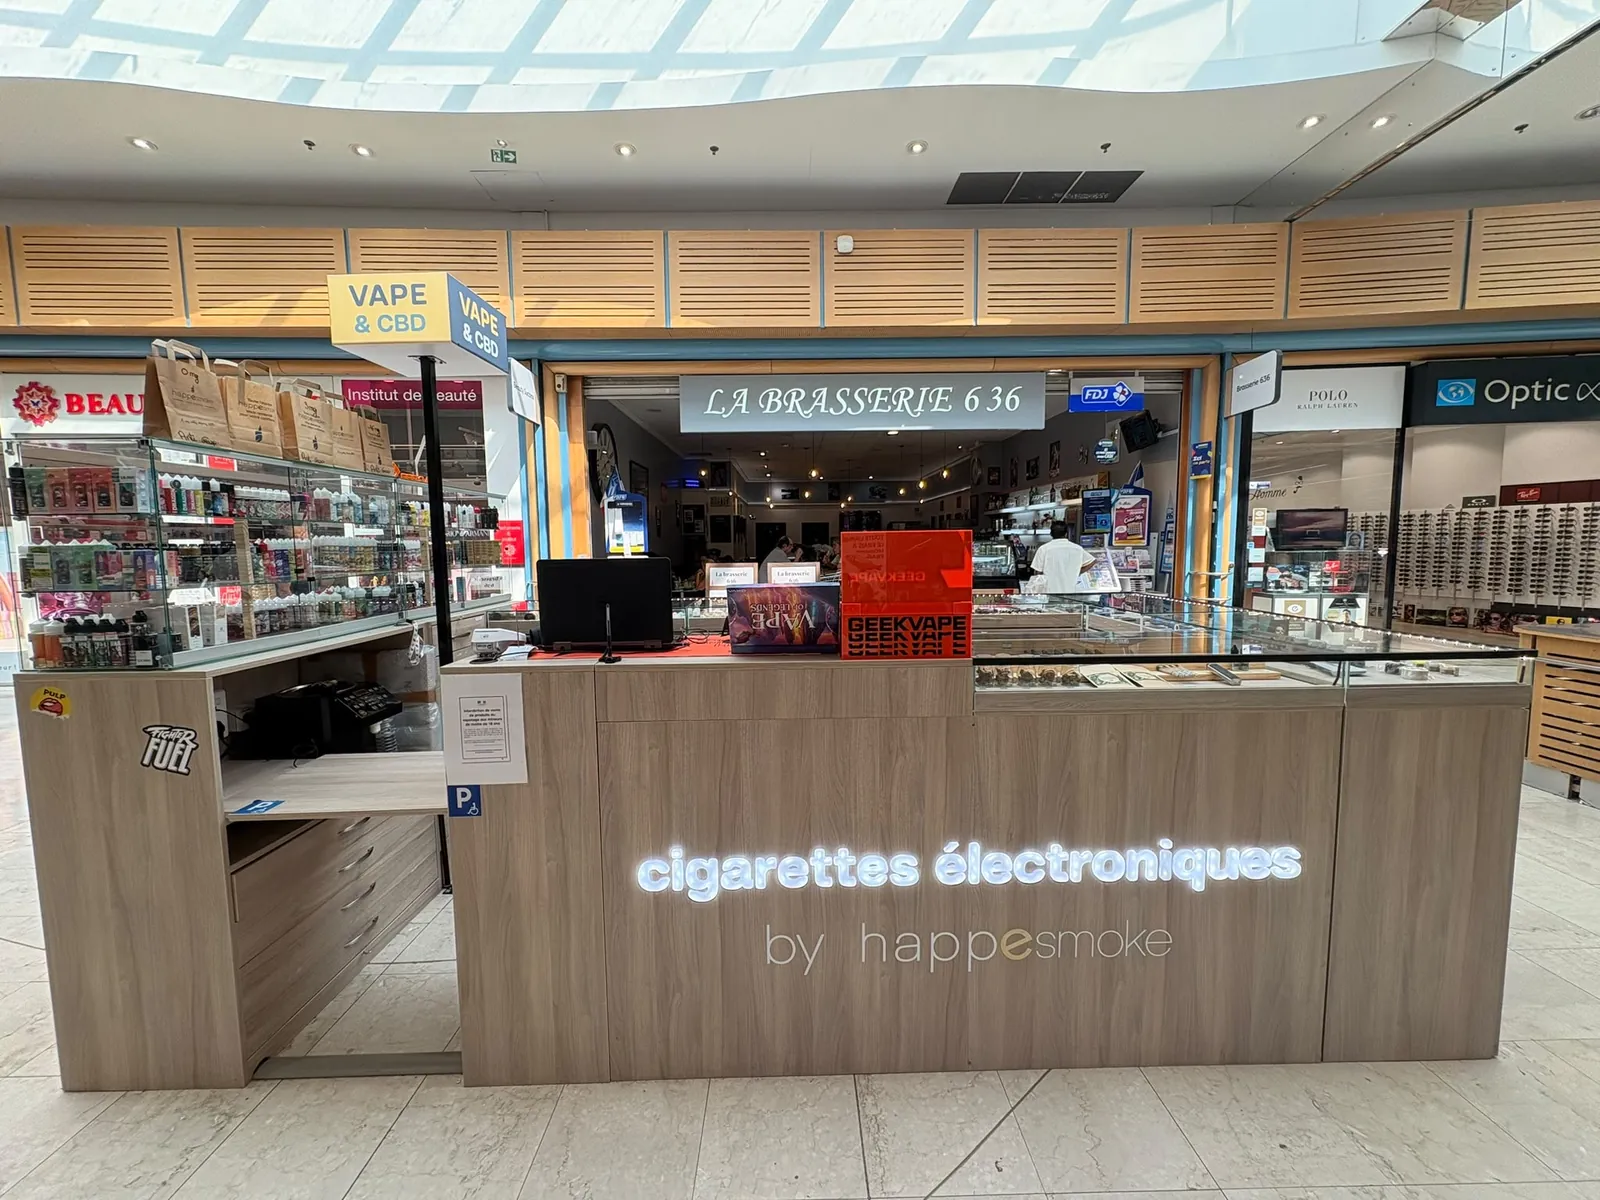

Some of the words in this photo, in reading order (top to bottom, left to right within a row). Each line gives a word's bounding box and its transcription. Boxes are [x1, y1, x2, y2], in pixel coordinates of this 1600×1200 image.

[349, 283, 427, 307] VAPE
[354, 315, 370, 333] &
[377, 313, 426, 332] CBD
[458, 291, 499, 337] VAPE
[462, 323, 473, 344] &
[474, 329, 499, 358] CBD
[1084, 388, 1109, 400] FDJ
[1236, 379, 1259, 393] Brasserie
[1259, 373, 1271, 385] 636
[1484, 377, 1570, 410] Optic
[347, 388, 399, 401] Institut
[402, 388, 422, 402] de
[436, 389, 477, 402] eauté
[703, 387, 750, 418] LA
[758, 386, 953, 418] BRASSERIE
[1309, 389, 1348, 401] POLO
[1250, 488, 1288, 500] Homme
[750, 603, 791, 612] LEGENDS
[751, 609, 817, 631] VAPE
[848, 615, 966, 631] GEEKVAPE
[43, 688, 66, 700] PULP
[144, 726, 199, 749] FIGHTER
[142, 737, 194, 775] FUEL
[456, 787, 473, 809] P
[637, 846, 920, 902] cigarettes
[934, 837, 1302, 892] électroniques
[766, 924, 825, 976] by
[861, 919, 1174, 974] happesmoke
